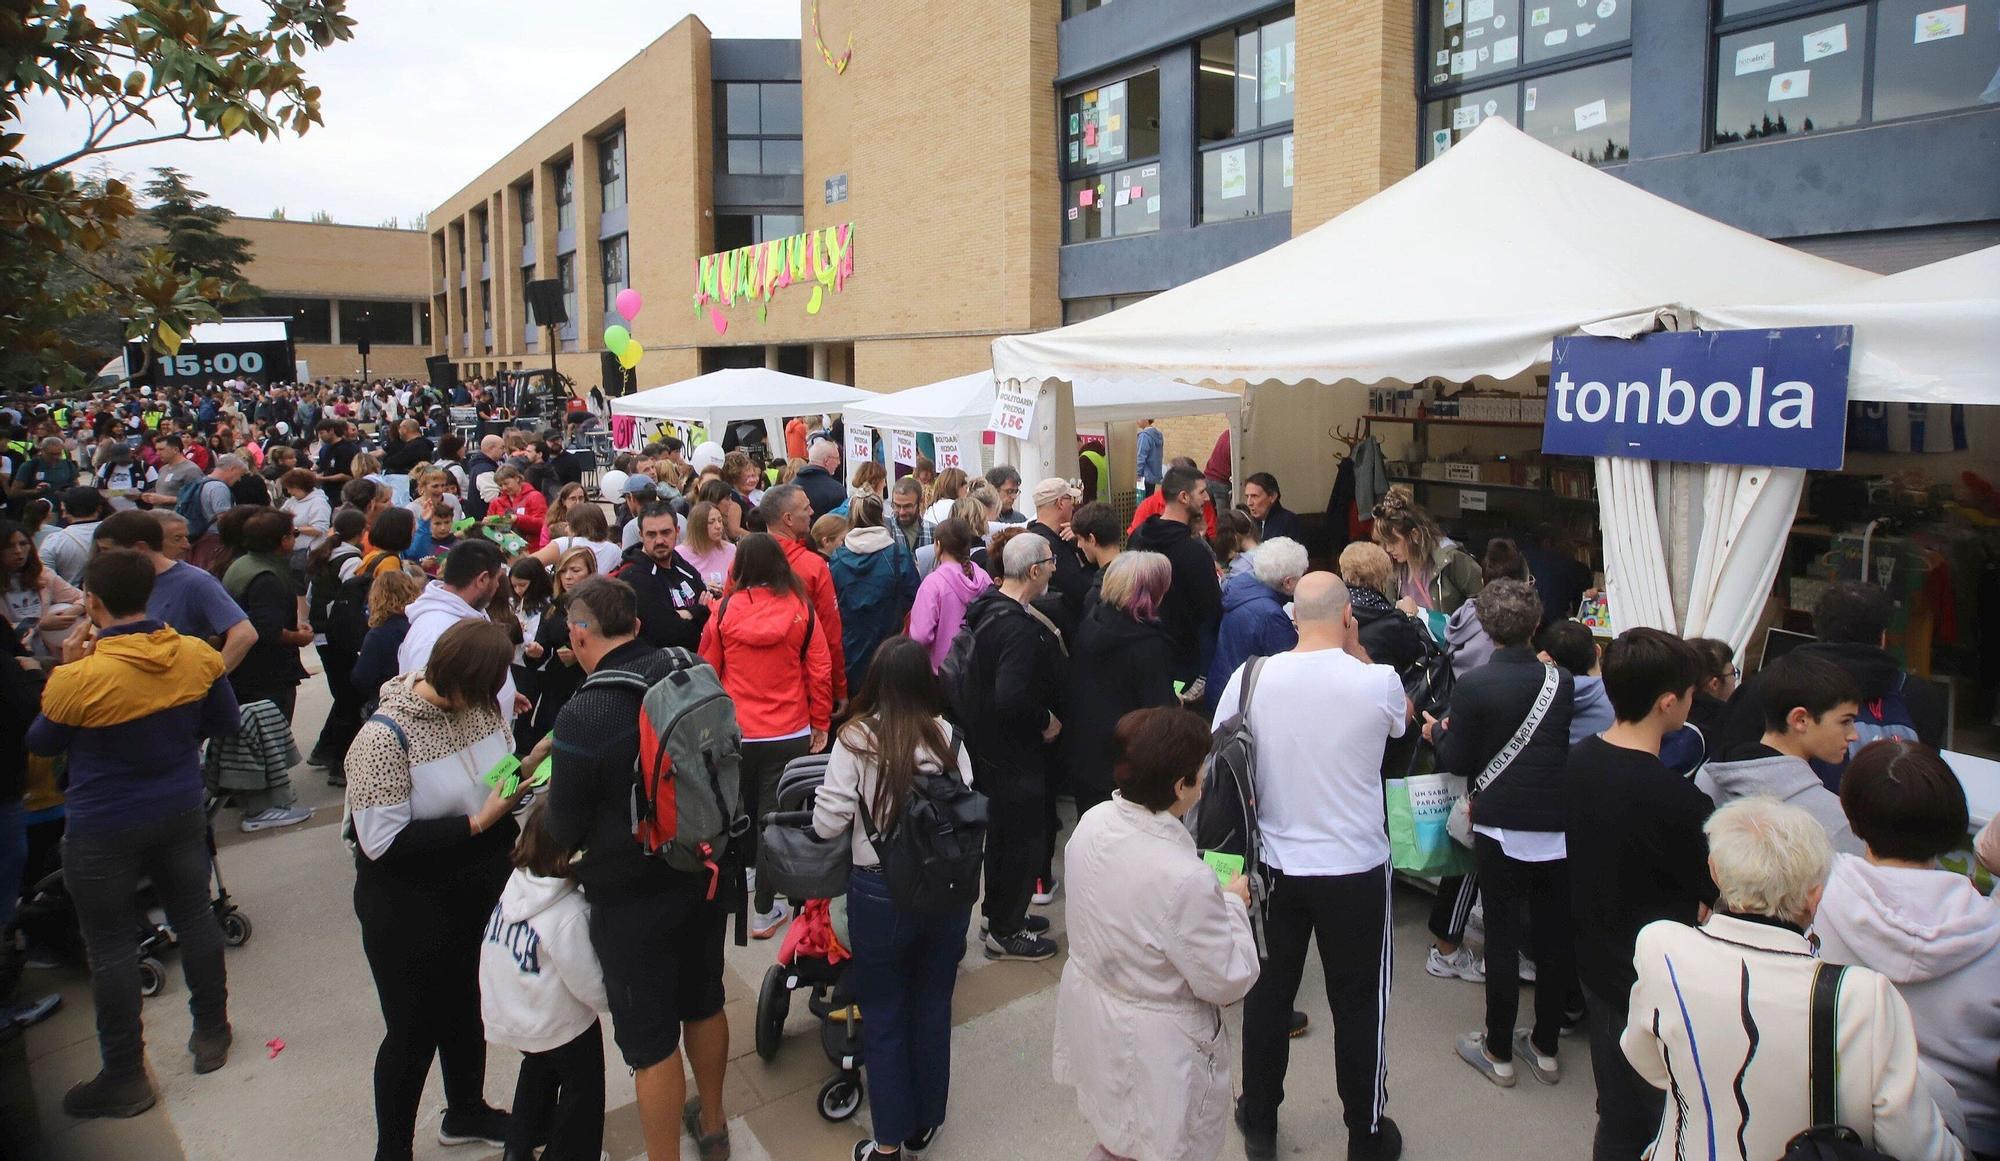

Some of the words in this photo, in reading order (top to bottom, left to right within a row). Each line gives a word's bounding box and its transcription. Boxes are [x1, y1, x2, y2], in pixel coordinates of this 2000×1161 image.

[157, 352, 263, 377] 15:00
[1555, 366, 1815, 429] tonbola
[1000, 413, 1024, 430] 1,5€
[854, 444, 868, 456] 1,5€
[897, 445, 912, 459] 1,5€
[940, 454, 959, 468] 1,5€
[1489, 752, 1511, 774] LOLA
[1536, 686, 1554, 713] LOLA
[483, 901, 541, 974] TITCH
